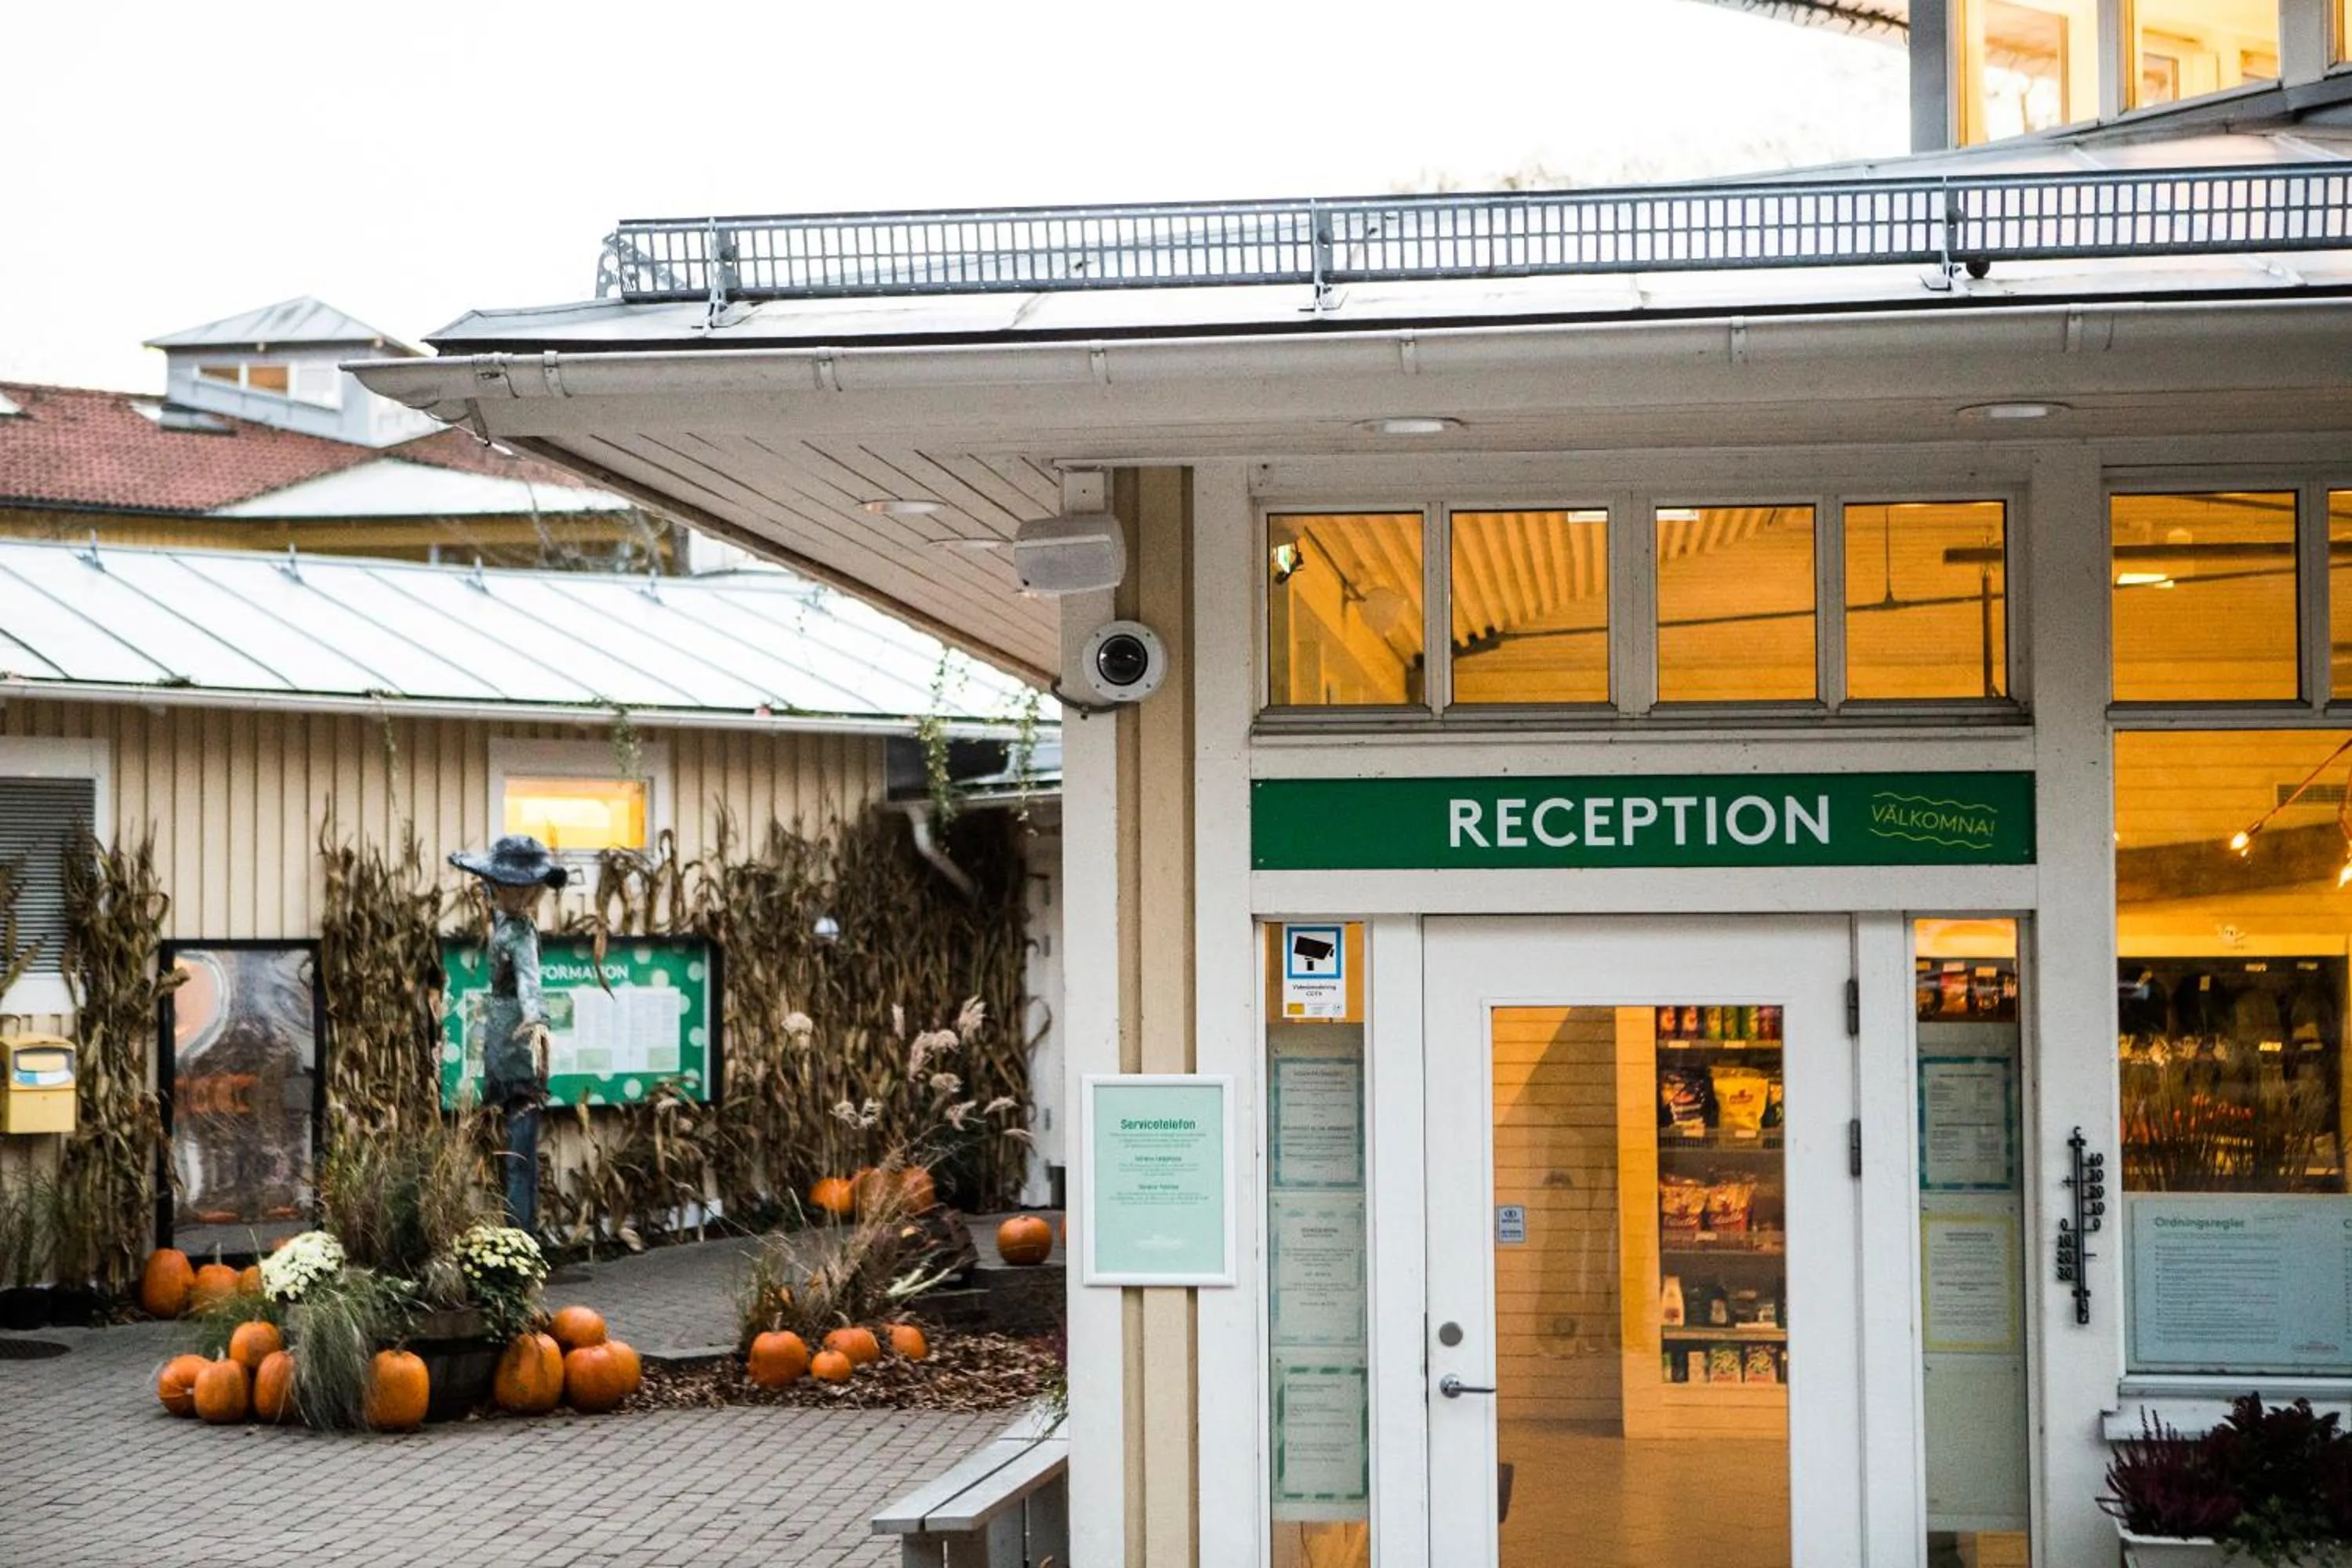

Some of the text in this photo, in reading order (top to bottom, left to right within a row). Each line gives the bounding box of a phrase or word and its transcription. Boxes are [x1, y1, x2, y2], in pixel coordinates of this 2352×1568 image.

[1450, 795, 1830, 848] RECEPTION
[1871, 803, 1995, 838] VÄLKOMNA!
[1120, 1119, 1196, 1130] Servicetelefon
[2155, 1217, 2245, 1229] Ordningsregler
